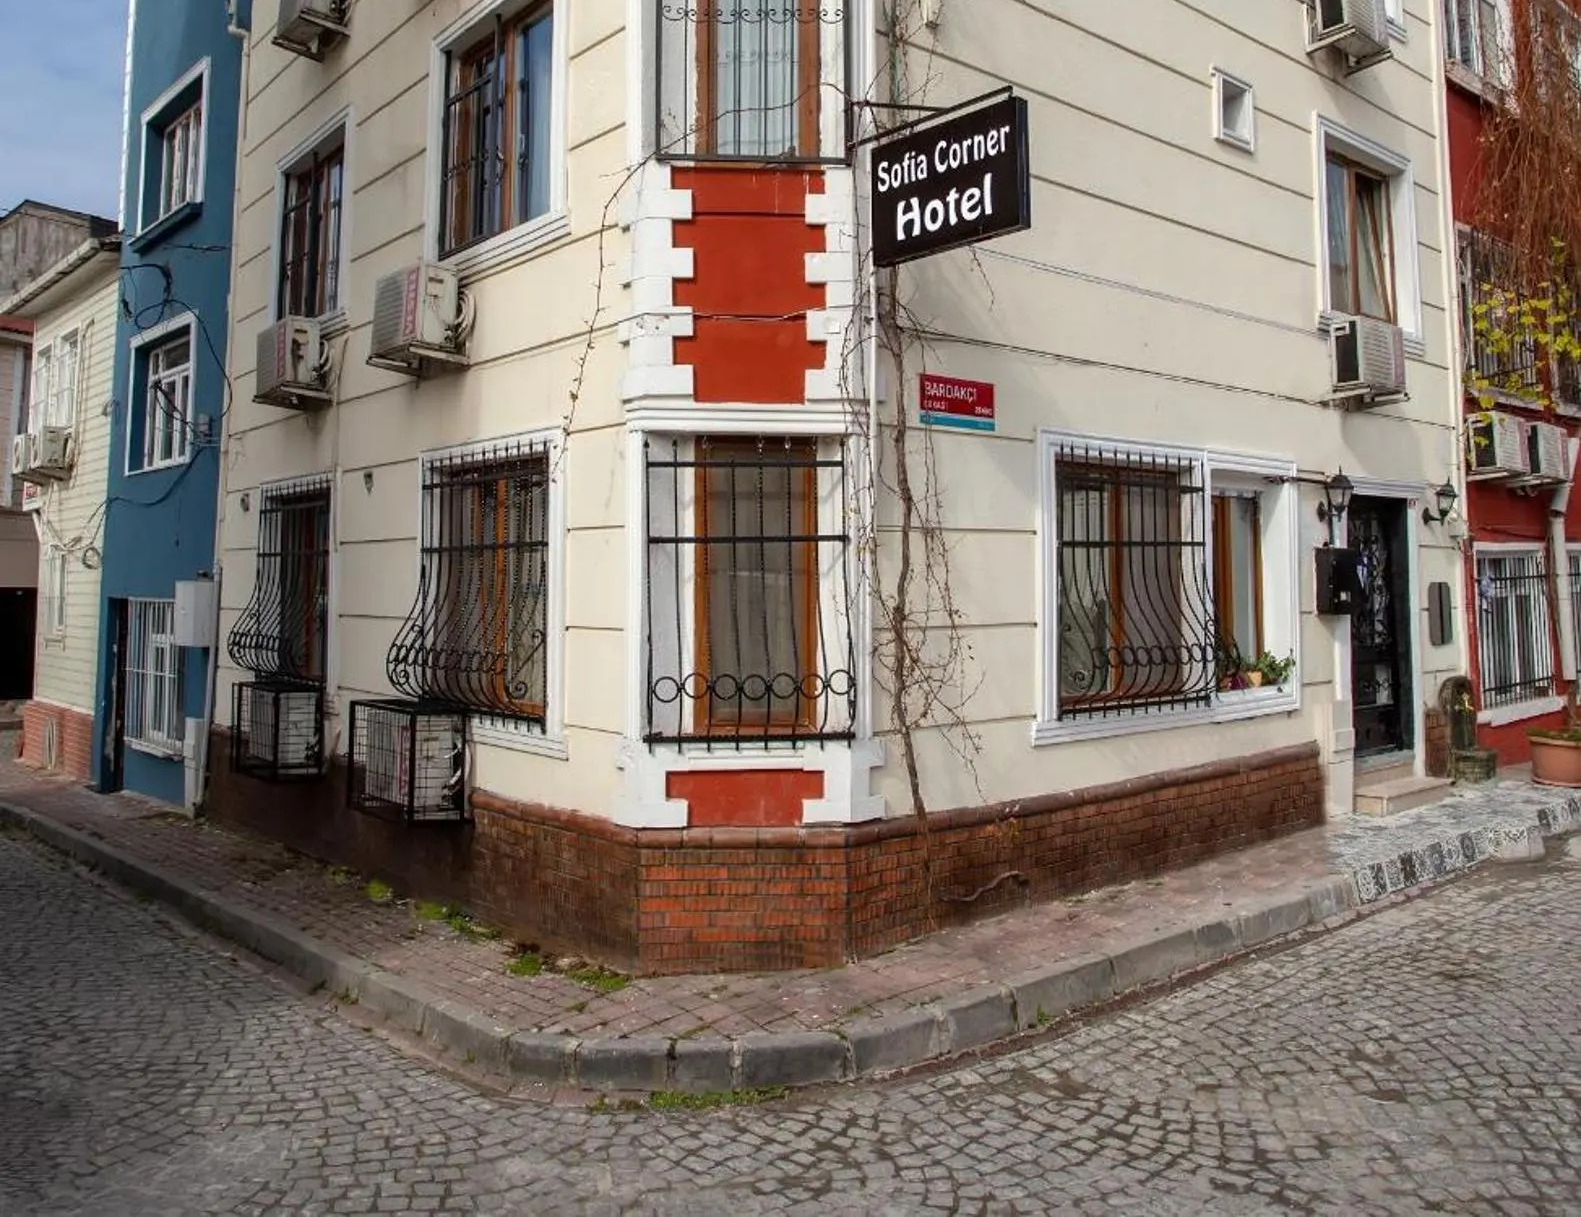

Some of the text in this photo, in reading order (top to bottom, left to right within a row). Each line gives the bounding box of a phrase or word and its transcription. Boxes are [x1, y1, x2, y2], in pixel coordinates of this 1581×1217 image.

[877, 125, 1010, 193] Sofia Corner
[896, 172, 993, 241] Hotel
[924, 381, 977, 403] BARDAKÇI
